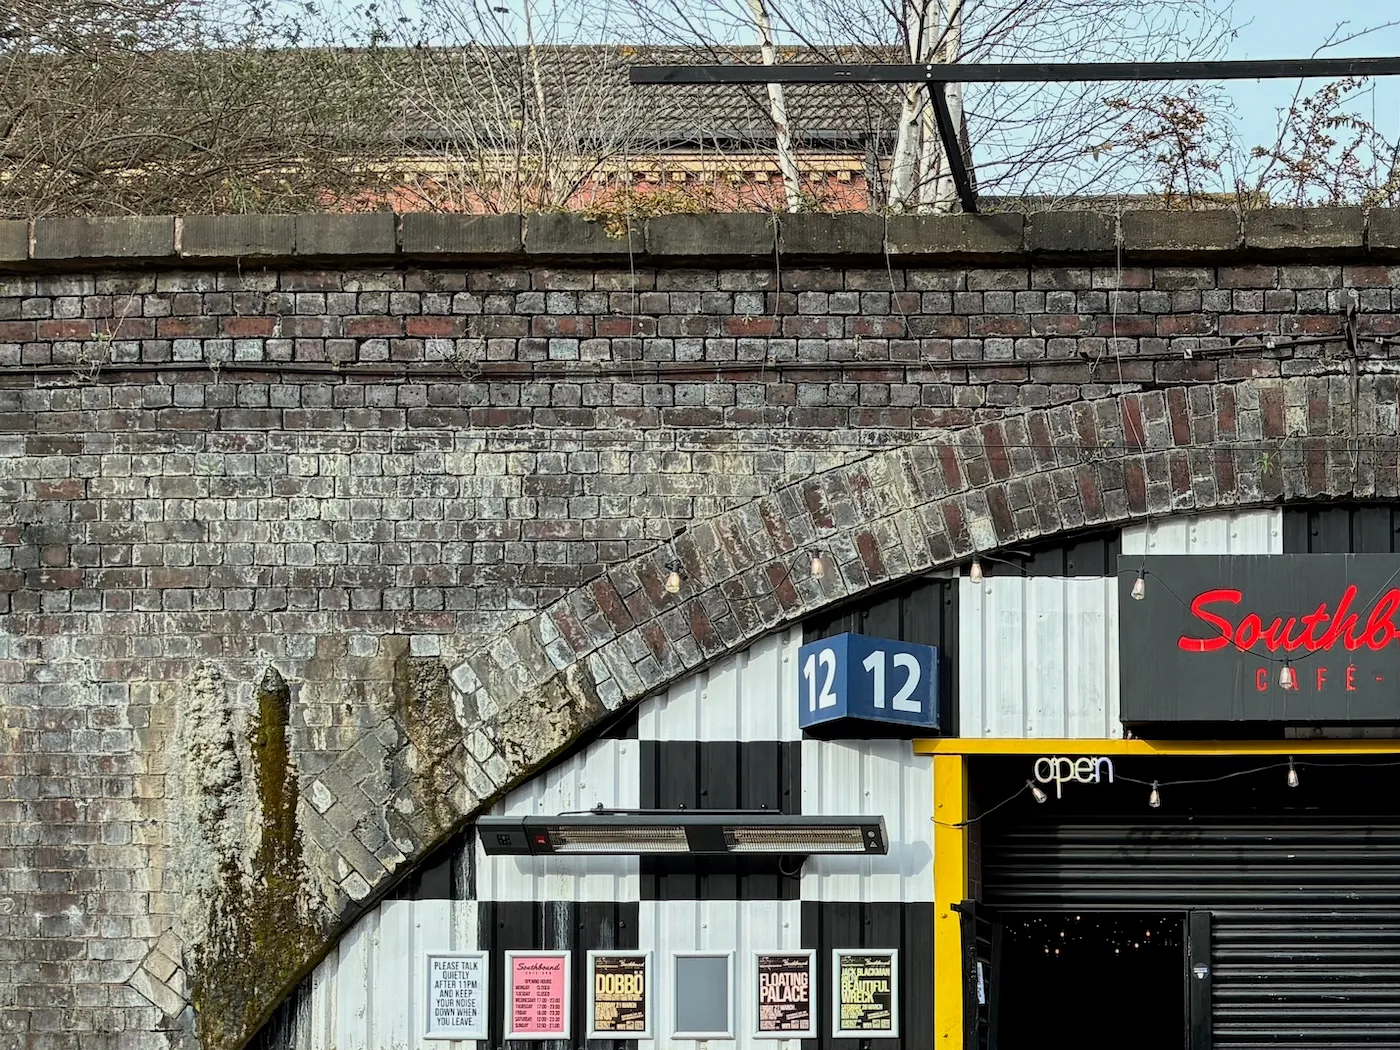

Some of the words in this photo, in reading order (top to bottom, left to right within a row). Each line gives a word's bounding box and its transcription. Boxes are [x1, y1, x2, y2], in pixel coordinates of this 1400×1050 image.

[803, 648, 837, 713] 12
[862, 650, 922, 714] 12
[1034, 756, 1114, 799] open
[434, 962, 459, 970] PLEASE
[461, 962, 478, 970] TALK
[443, 971, 470, 979] QUIETLY
[857, 968, 890, 976] BLACKMAN
[435, 980, 456, 988] AFTER
[459, 980, 477, 988] 11PM
[596, 970, 644, 994] DOBBÖ
[760, 972, 808, 986] FLOATING
[842, 980, 890, 992] BEAUTIFUL
[760, 986, 808, 1002] PALACE
[842, 992, 874, 1003] WRECK
[436, 999, 454, 1007] YOUR
[456, 999, 476, 1007] NOISE
[435, 1008, 455, 1016] DOWN
[457, 1008, 477, 1016] WHEN
